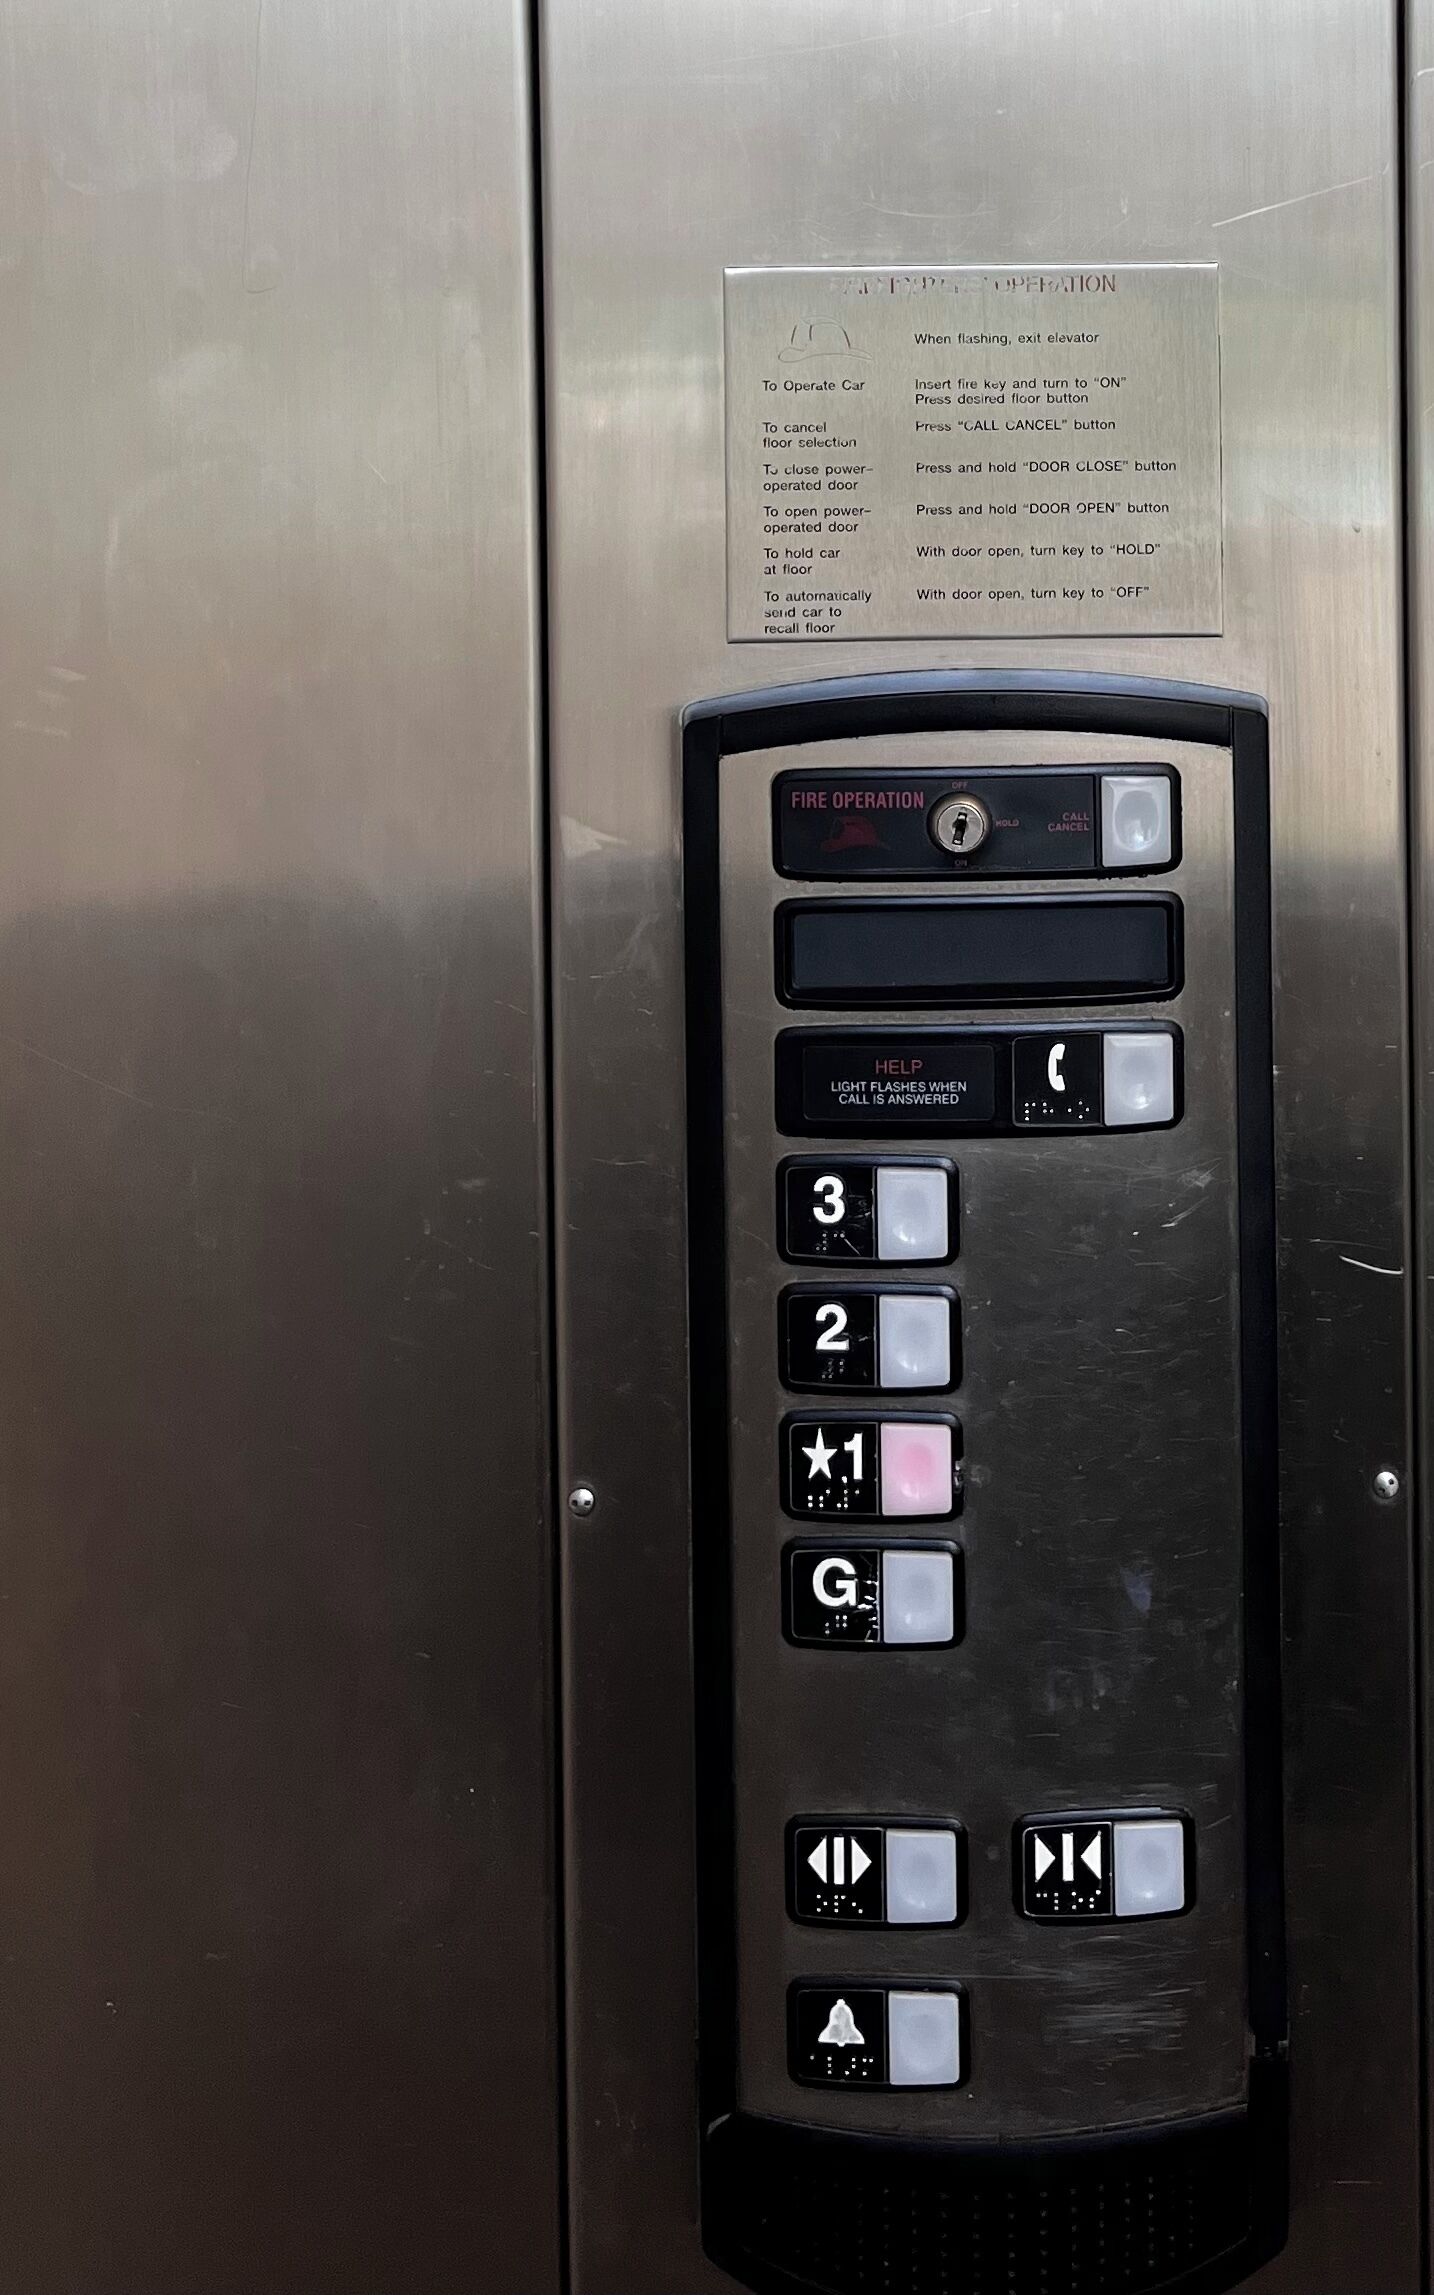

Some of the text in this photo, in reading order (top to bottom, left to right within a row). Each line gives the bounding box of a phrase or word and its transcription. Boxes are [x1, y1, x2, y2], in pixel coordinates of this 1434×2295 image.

[913, 331, 1100, 347] When flashing, exit elevator
[761, 379, 866, 394] To Operate Car
[914, 378, 952, 390] Insert
[957, 377, 978, 390] fire
[983, 378, 1007, 393] key
[1012, 377, 1037, 390] and
[1042, 378, 1069, 389] turn
[1074, 377, 1088, 389] to
[915, 392, 1089, 405] Press desired floor button
[761, 421, 827, 434] To cancel
[915, 420, 952, 432] Press
[1073, 418, 1116, 431] button
[762, 436, 857, 449] floor selection
[762, 463, 779, 476] To
[784, 463, 820, 476] close
[915, 461, 952, 474] Press
[957, 461, 983, 474] and
[988, 461, 1017, 473] hold
[1134, 460, 1177, 472] button
[762, 479, 859, 494] operated door
[762, 505, 779, 518] To
[784, 507, 818, 520] open
[916, 503, 953, 516] Press
[958, 503, 983, 515] and
[988, 503, 1017, 515] hold
[1127, 501, 1170, 514] button
[763, 520, 860, 536] operated door
[762, 546, 841, 560] To hold car
[915, 544, 946, 558] With
[951, 545, 983, 558] door
[987, 544, 1024, 559] open,
[1030, 545, 1056, 557] turn
[1062, 544, 1085, 559] key
[1090, 544, 1104, 556] to
[763, 563, 813, 576] at floor
[763, 589, 873, 604] To automatically
[916, 588, 946, 601] With
[951, 588, 983, 600] door
[988, 589, 1025, 602] open,
[1030, 587, 1057, 599] turn
[1062, 586, 1086, 602] key
[1090, 587, 1105, 599] to
[764, 606, 842, 619] send car to
[764, 621, 836, 635] recall floor
[951, 781, 969, 790] OFF
[791, 791, 924, 809] FIRE OPERATION
[995, 819, 1020, 828] HOLD
[1062, 812, 1090, 822] CALL
[1047, 821, 1090, 832] CANCEL
[875, 1059, 924, 1075] HELP
[831, 1080, 967, 1093] LIGHT FLASHES WHEN
[838, 1093, 960, 1105] CALL IS ANSWERED
[812, 1174, 845, 1225] 3
[814, 1302, 850, 1352] 2
[812, 1557, 857, 1608] G
